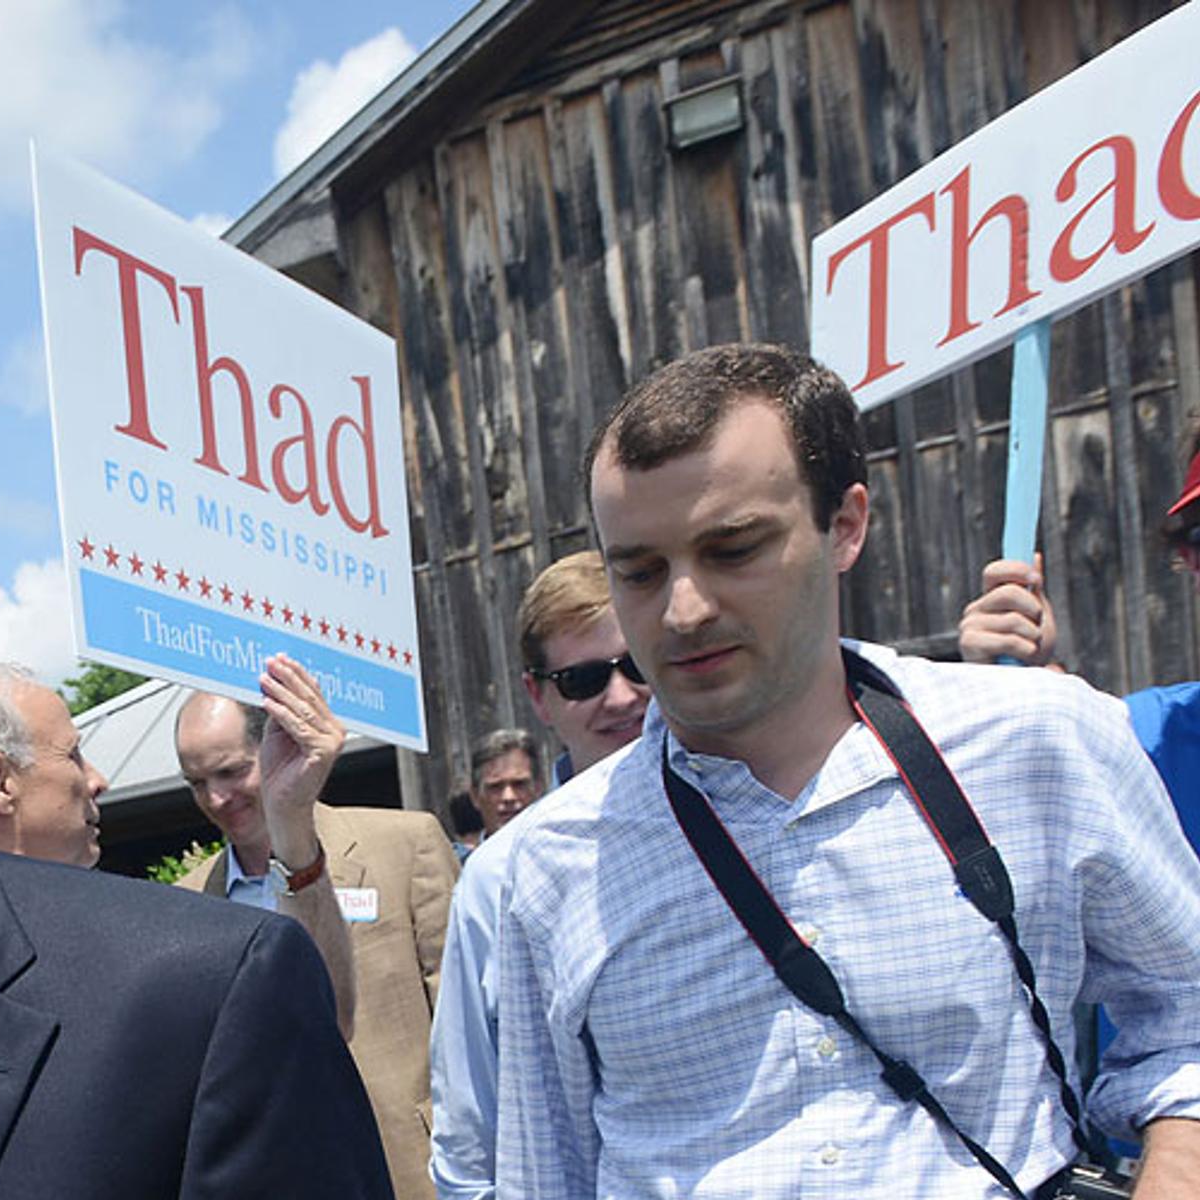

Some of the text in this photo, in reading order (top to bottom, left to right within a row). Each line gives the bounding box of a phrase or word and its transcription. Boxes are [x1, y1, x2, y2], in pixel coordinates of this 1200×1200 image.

[72, 225, 389, 539] Thad
[104, 459, 388, 596] FOR MISSISSIPPI
